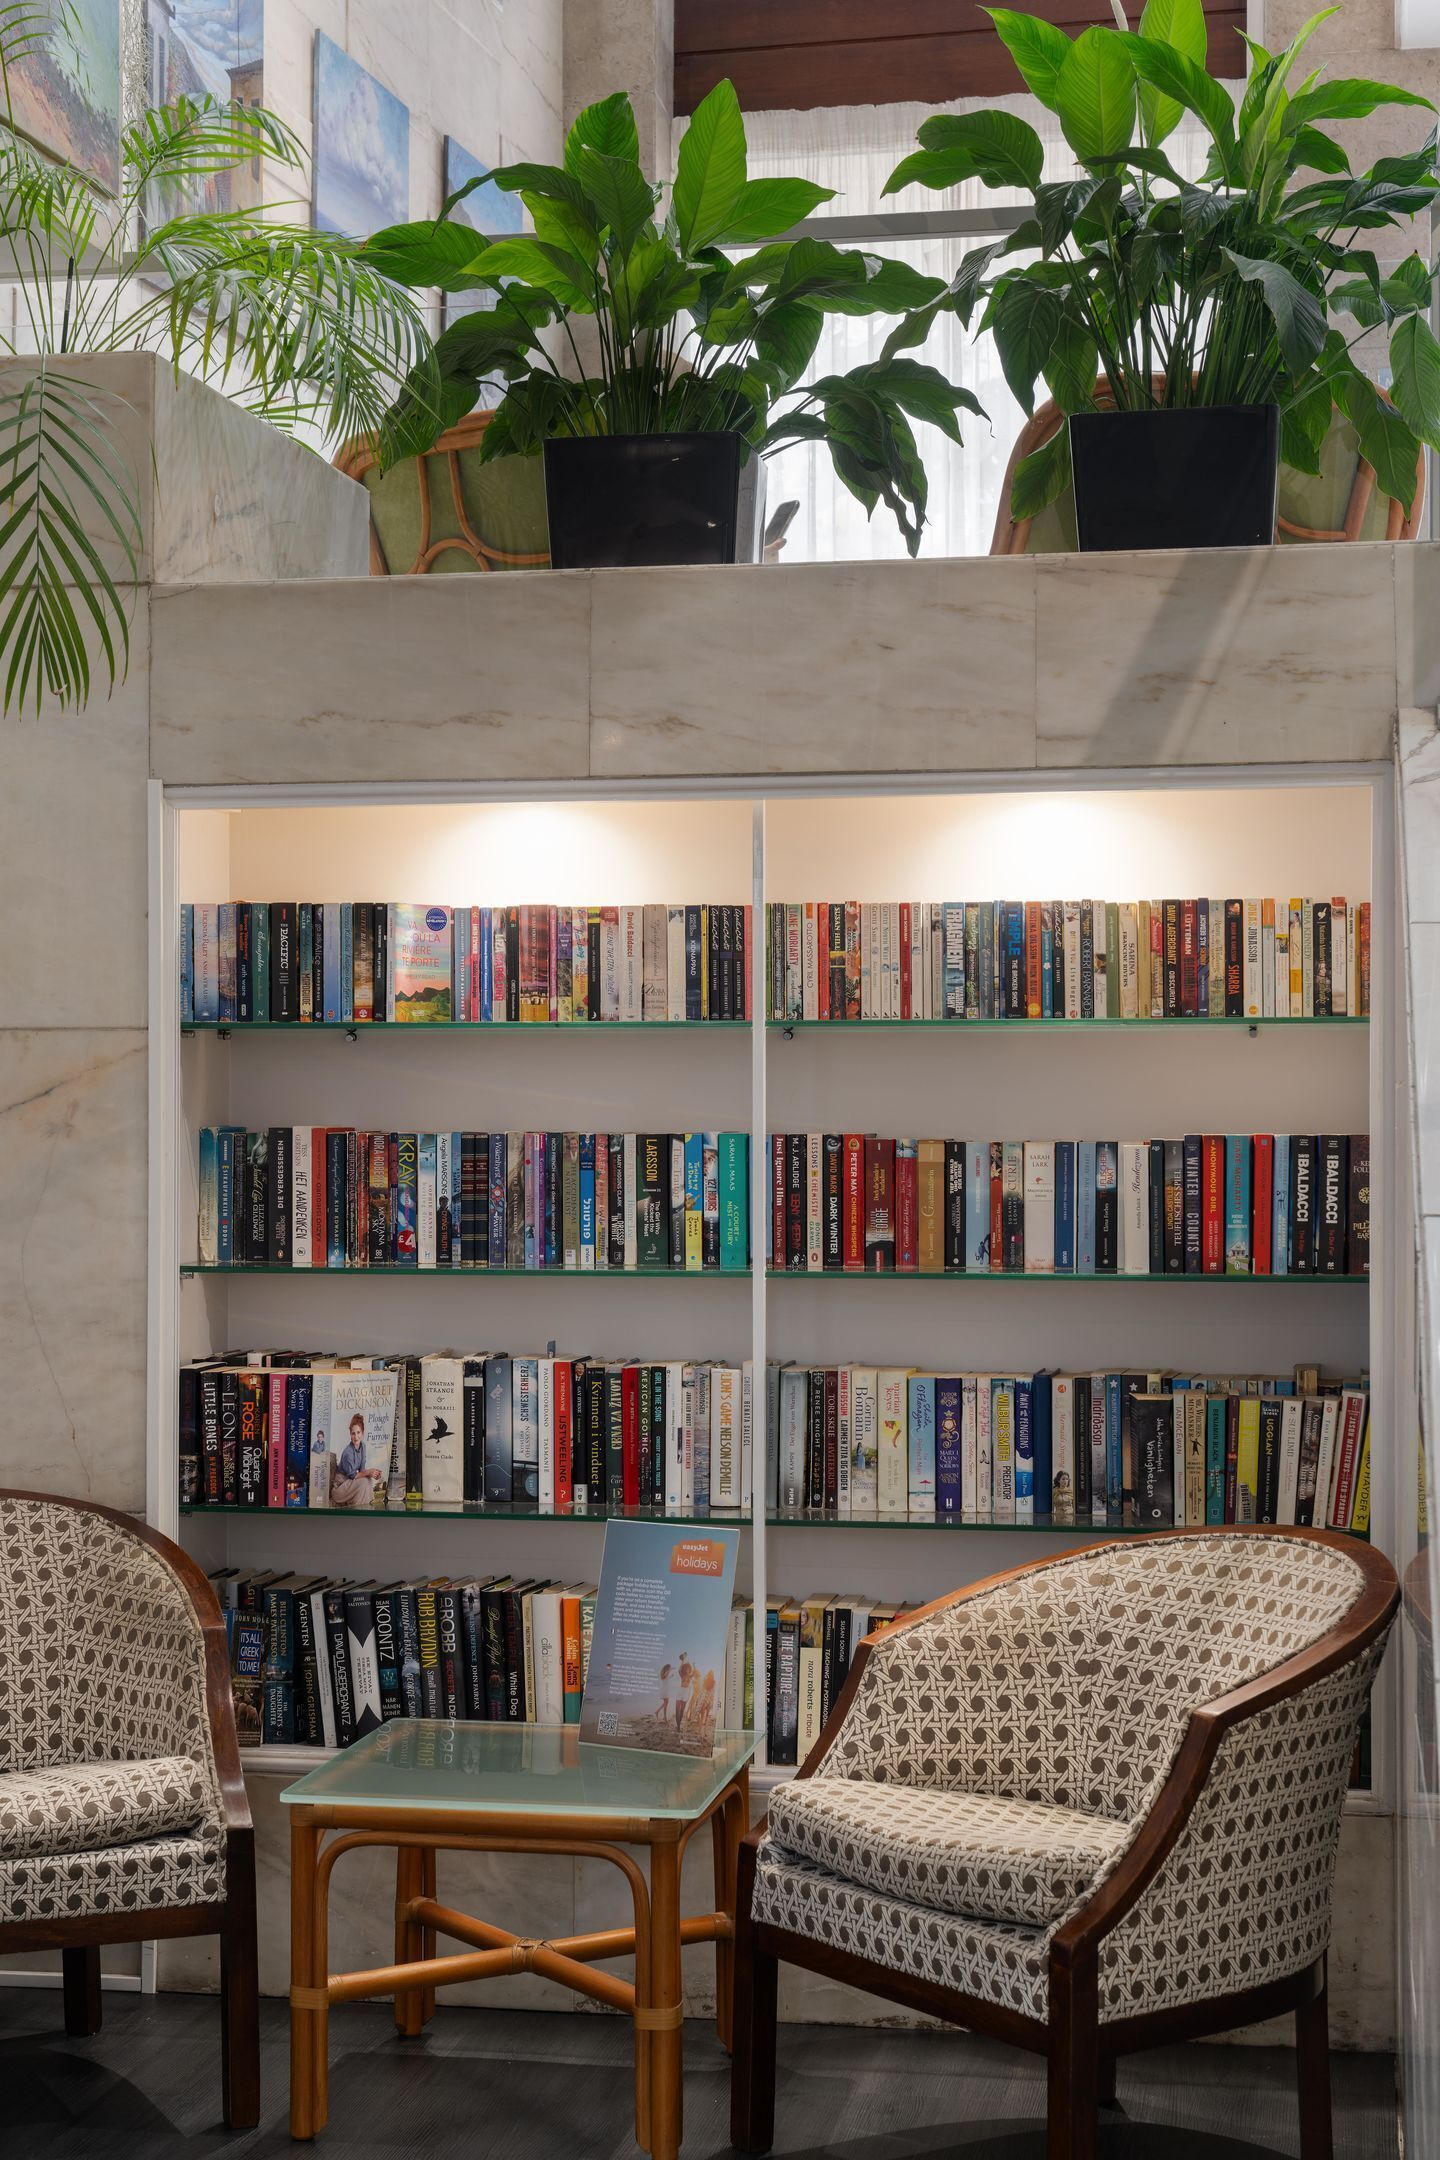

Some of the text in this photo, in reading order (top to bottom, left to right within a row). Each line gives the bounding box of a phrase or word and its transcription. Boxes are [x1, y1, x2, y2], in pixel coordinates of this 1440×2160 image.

[1248, 903, 1257, 926] JONAS
[1304, 906, 1312, 924] LENA
[280, 928, 289, 969] PACIFIC
[947, 908, 964, 970] FRAGMENT
[1248, 927, 1257, 963] JONASSON
[1304, 927, 1312, 960] KENNEDY
[1083, 938, 1091, 1010] ROBERT BARNARD
[947, 992, 956, 1008] FAHY
[955, 986, 964, 1013] WARREN
[374, 1135, 385, 1188] NORA ROBERTS
[399, 1139, 415, 1188] KRAY
[646, 1139, 657, 1182] LARSSON
[775, 1157, 783, 1185] Ignore
[295, 1171, 307, 1239] HET AANDENKEN
[708, 1178, 717, 1212] 127 HOURS
[1187, 1157, 1199, 1252] WINTER COUNTS
[1297, 1158, 1309, 1222] BALDACCI
[1326, 1160, 1339, 1224] BALDACCI
[583, 1198, 592, 1239] פורטוגל
[829, 1197, 837, 1220] DARK
[829, 1222, 838, 1254] WINTER
[336, 1385, 393, 1398] MARGARET
[520, 1365, 529, 1422] SCHWESTERHERZ
[654, 1372, 662, 1386] GIRL
[204, 1382, 217, 1451] LITTLE BONES
[222, 1392, 236, 1440] LEON
[272, 1379, 281, 1443] HELLO BEAUTIFUL
[290, 1389, 298, 1410] Swan
[298, 1388, 306, 1411] Karen
[335, 1396, 392, 1411] DICKINSON
[591, 1381, 602, 1429] Kvinnen
[641, 1369, 649, 1454] MEXICAN GOTHIC
[654, 1394, 662, 1405] THE
[654, 1407, 662, 1422] SONG
[855, 1387, 867, 1441] Bomann
[864, 1396, 875, 1433] Corina
[885, 1387, 893, 1412] keyes
[893, 1383, 901, 1414] marian
[242, 1401, 254, 1441] ROSE
[297, 1418, 306, 1454] Midnight
[368, 1412, 389, 1424] Plough
[373, 1424, 383, 1432] the
[720, 1373, 732, 1495] LION'S GAME NELSON DEMILLE
[997, 1394, 1011, 1461] WILBUR SMITH
[1019, 1393, 1029, 1449] AWAY PENGUINS
[1092, 1397, 1104, 1446] Indriðason
[1212, 1408, 1220, 1441] BENJAMIN
[290, 1431, 298, 1452] Snow
[366, 1432, 391, 1442] Furrow
[1265, 1418, 1274, 1456] UGGLAN
[591, 1440, 602, 1484] vinduet
[1144, 1440, 1156, 1497] Vänligheten
[1003, 1465, 1012, 1500] PREDATOR
[676, 1554, 718, 1570] holidays
[682, 1543, 708, 1552] easyJet
[269, 1593, 278, 1617] JAMES
[419, 1593, 435, 1617] ROB
[582, 1606, 593, 1635] KATE
[376, 1606, 394, 1662] KOONTZ
[421, 1620, 438, 1668] BRYDON
[440, 1609, 456, 1653] ROBB
[780, 1635, 794, 1695] THE RAPTURE
[838, 1640, 846, 1662] SONTAG
[299, 1602, 317, 1738] AGENTEN JOHN GRISHAM
[334, 1633, 350, 1725] DAVID LAGERCRANTZ
[427, 1670, 436, 1688] Small
[446, 1659, 455, 1693] SECRETS
[469, 1635, 480, 1710] DEFENCE JOHN FAIRFAX
[509, 1671, 519, 1716] White Dog
[807, 1680, 815, 1710] roberts
[805, 1713, 813, 1738] tribute
